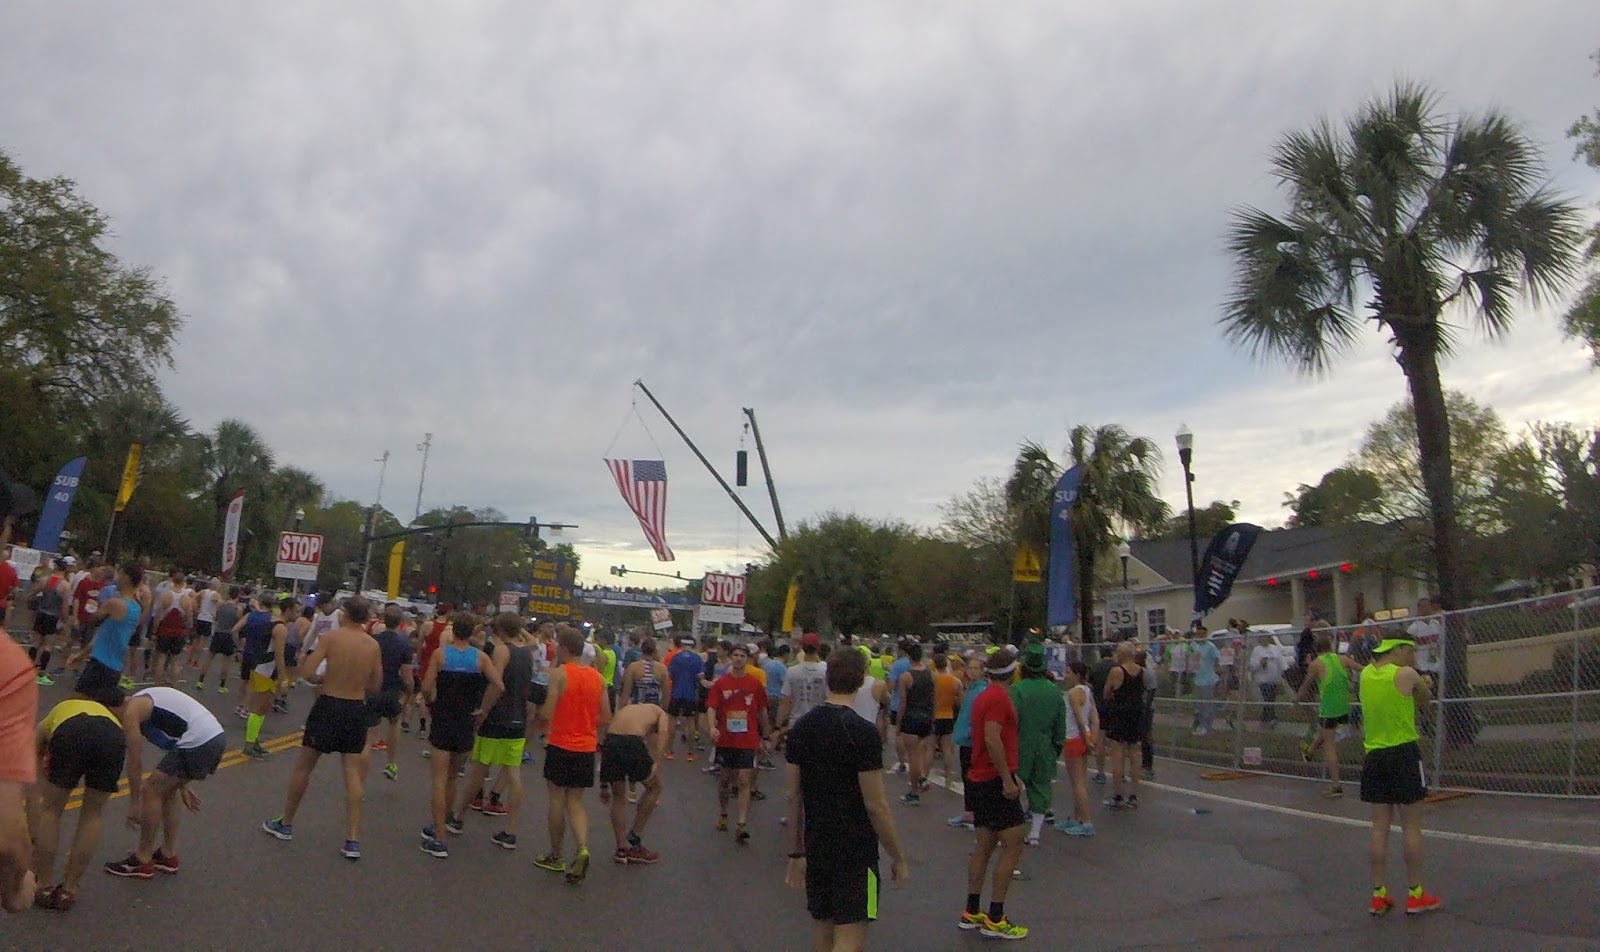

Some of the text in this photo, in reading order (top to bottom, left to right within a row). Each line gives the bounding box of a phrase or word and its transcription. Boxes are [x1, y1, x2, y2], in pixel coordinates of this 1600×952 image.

[54, 475, 79, 488] SUB
[54, 491, 70, 503] 40
[281, 534, 320, 562] STOP
[531, 584, 562, 600] ELITE
[705, 574, 743, 603] STOP
[501, 594, 519, 605] STOP
[528, 601, 571, 617] SEEDED
[652, 608, 670, 622] STOP
[1110, 610, 1132, 624] 35
